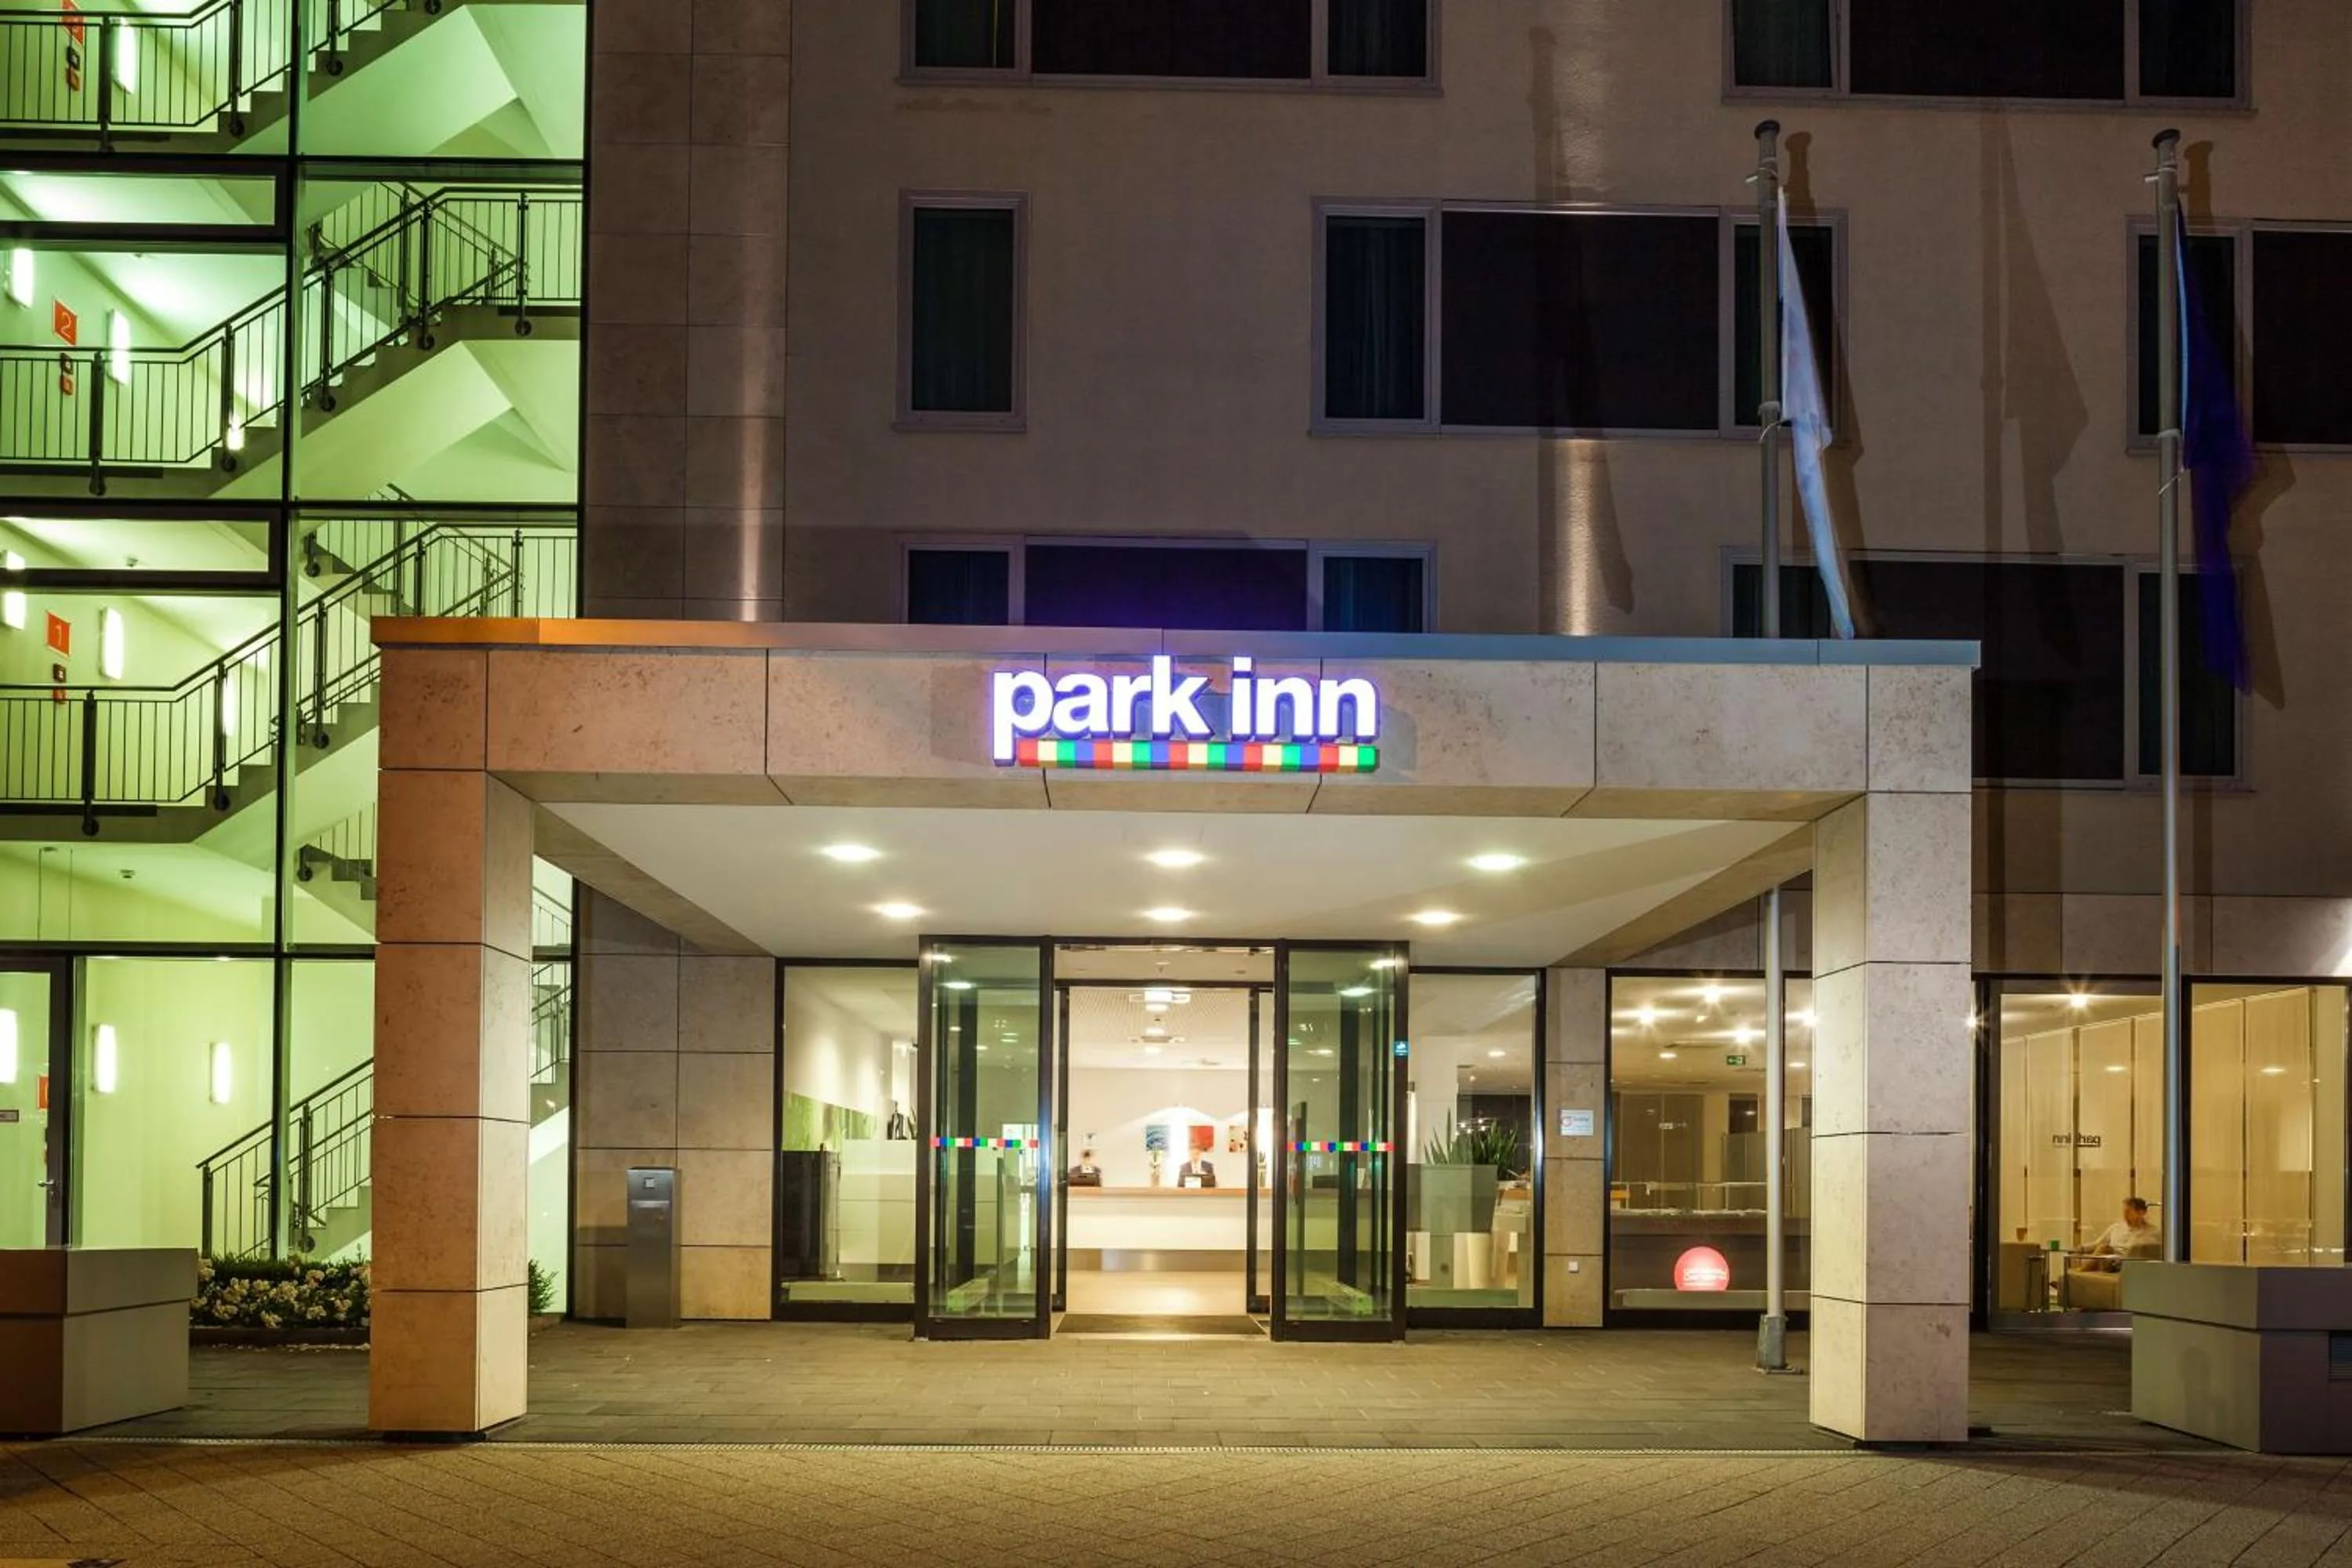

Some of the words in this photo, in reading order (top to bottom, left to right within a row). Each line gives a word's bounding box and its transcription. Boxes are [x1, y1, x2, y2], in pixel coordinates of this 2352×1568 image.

[61, 311, 72, 339] 2
[55, 624, 62, 648] 1
[993, 655, 1213, 765] park
[1232, 656, 1377, 742] inn
